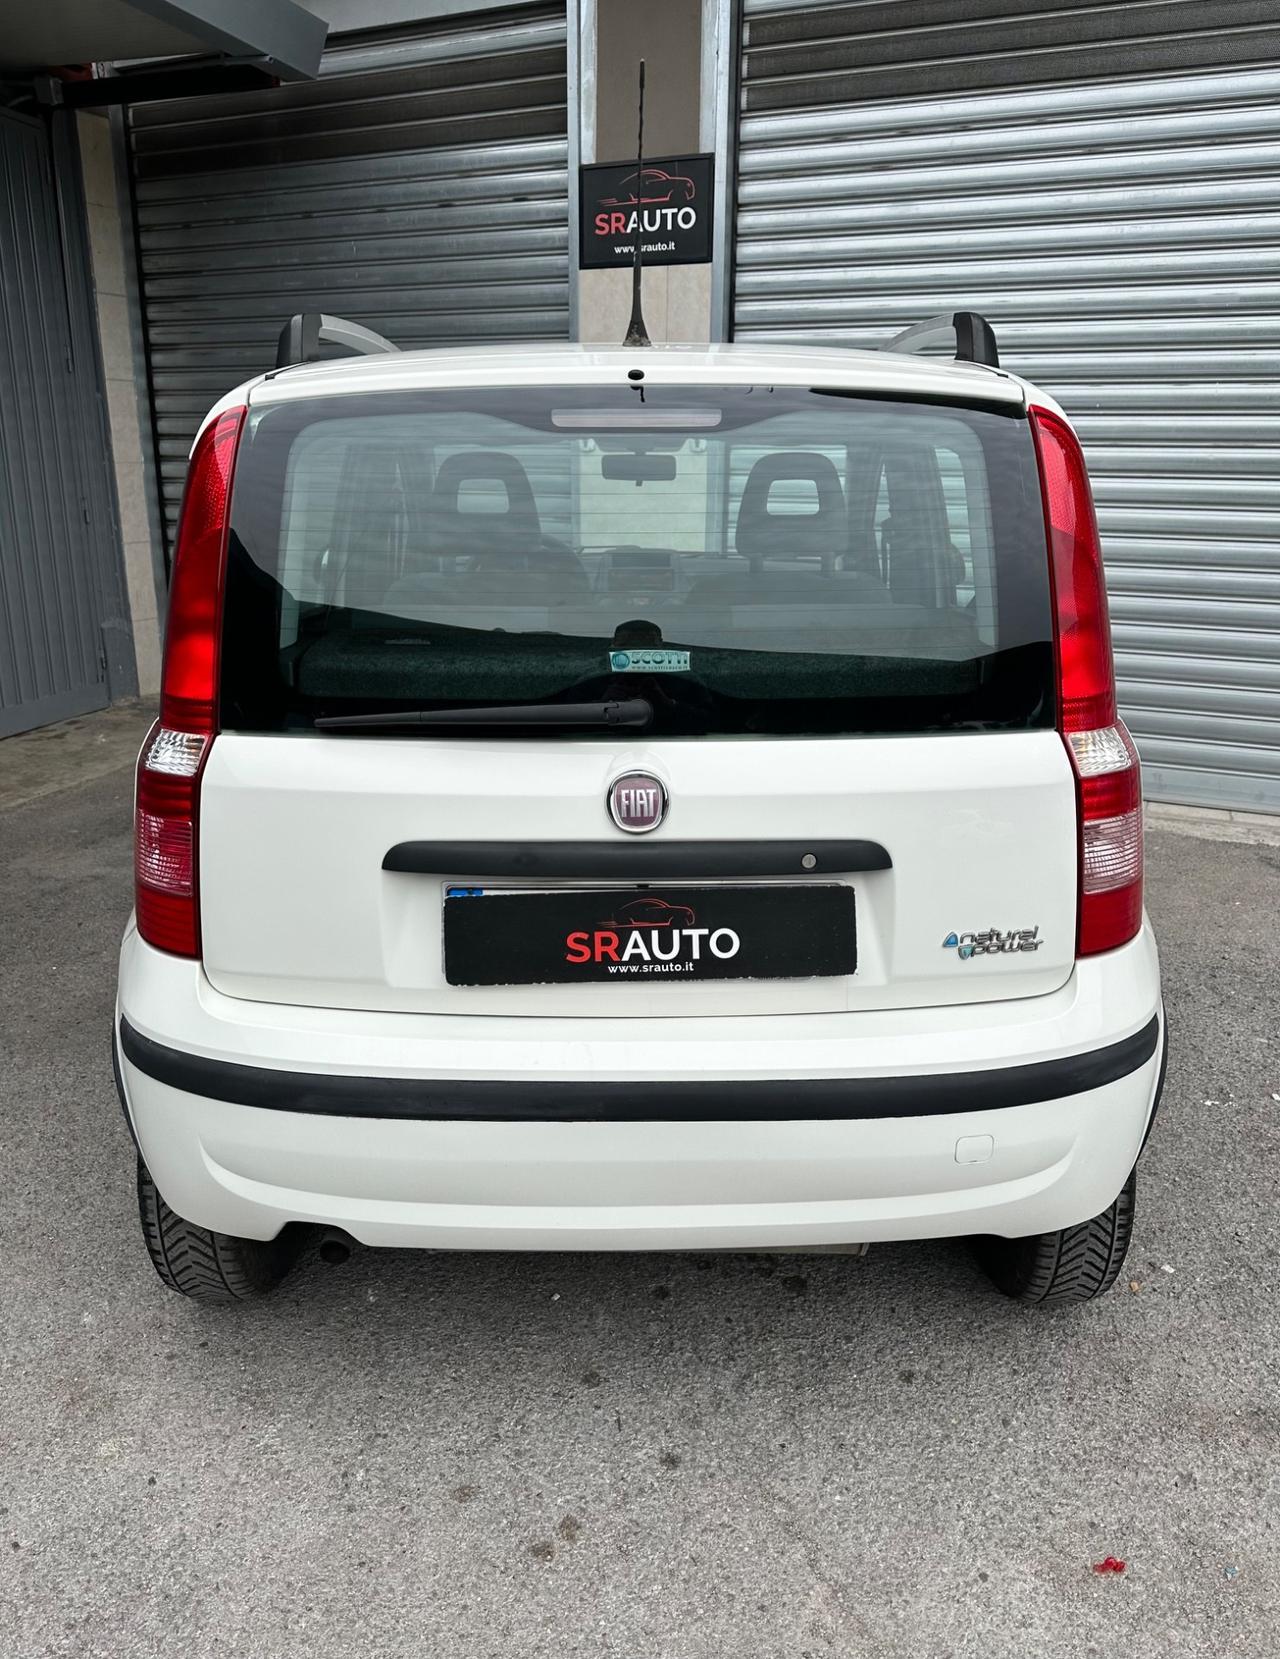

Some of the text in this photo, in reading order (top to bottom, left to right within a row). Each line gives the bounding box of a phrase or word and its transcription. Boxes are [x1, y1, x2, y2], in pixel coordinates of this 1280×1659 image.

[595, 206, 697, 235] SRAUTO
[613, 240, 676, 254] wwwrauto.it
[620, 788, 657, 818] FIAT
[960, 925, 1039, 944] natural
[565, 927, 741, 963] SRAUTO
[970, 939, 1044, 958] power
[607, 961, 695, 974] www.srauto.it
